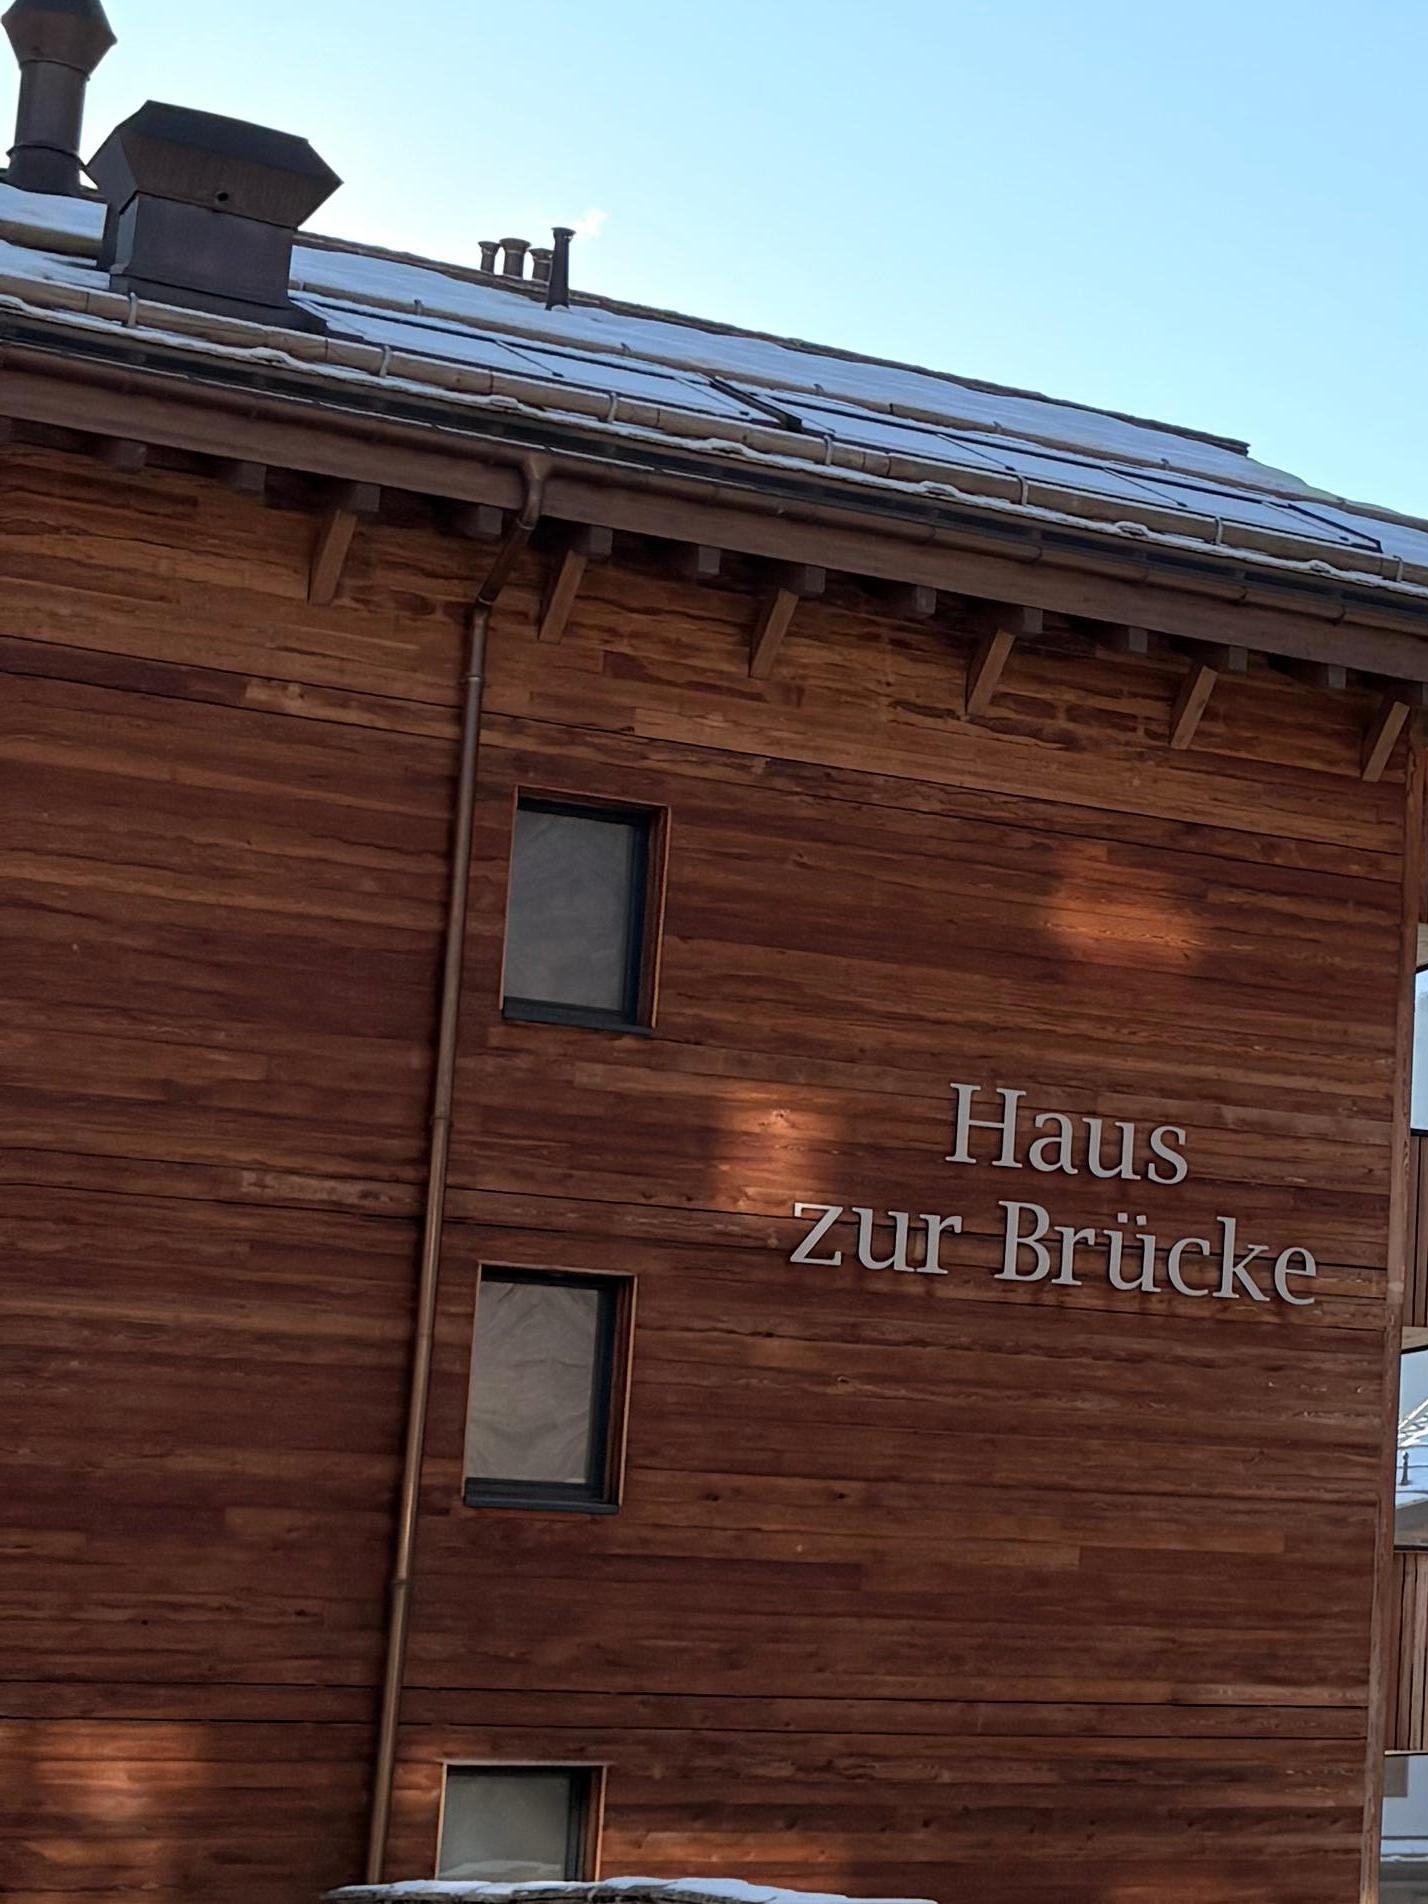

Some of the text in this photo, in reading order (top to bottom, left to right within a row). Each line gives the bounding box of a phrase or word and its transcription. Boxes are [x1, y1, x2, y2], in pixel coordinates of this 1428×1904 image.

[946, 1082, 1189, 1185] Haus
[790, 1200, 1318, 1306] zur Brücke
